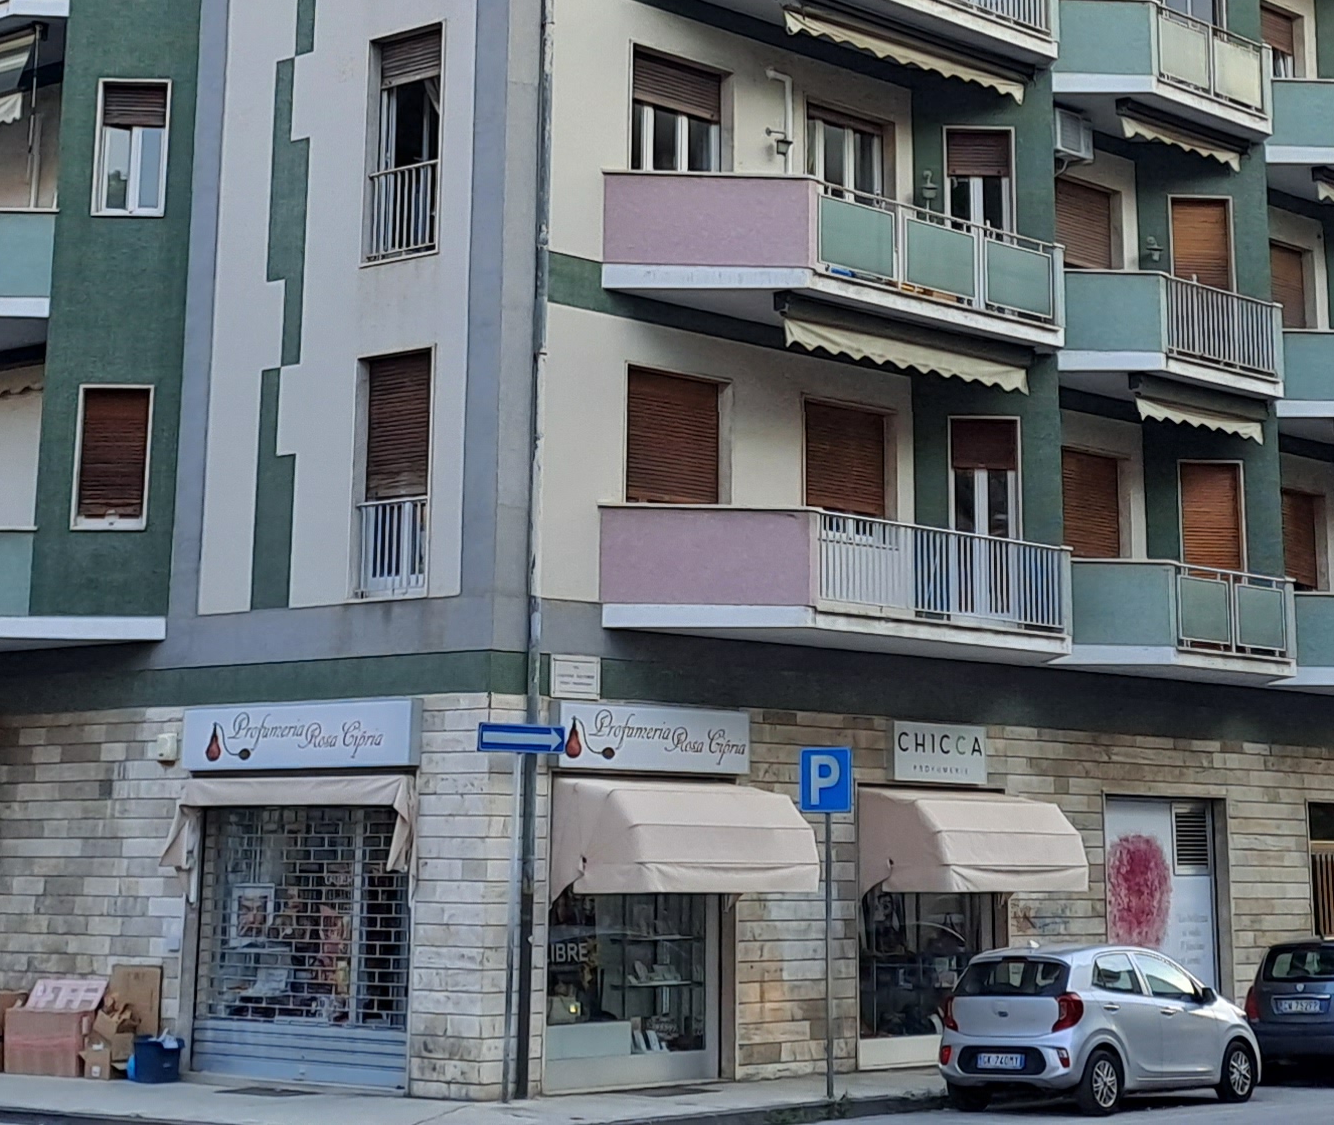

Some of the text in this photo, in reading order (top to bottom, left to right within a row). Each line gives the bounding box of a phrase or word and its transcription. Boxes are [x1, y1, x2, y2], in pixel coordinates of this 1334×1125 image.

[227, 712, 384, 759] Profumeria Rosa Cipria
[588, 709, 747, 765] Profumeria Rosa Cipria
[897, 732, 983, 757] CHICCA
[810, 754, 840, 805] P
[547, 942, 588, 962] IBRE
